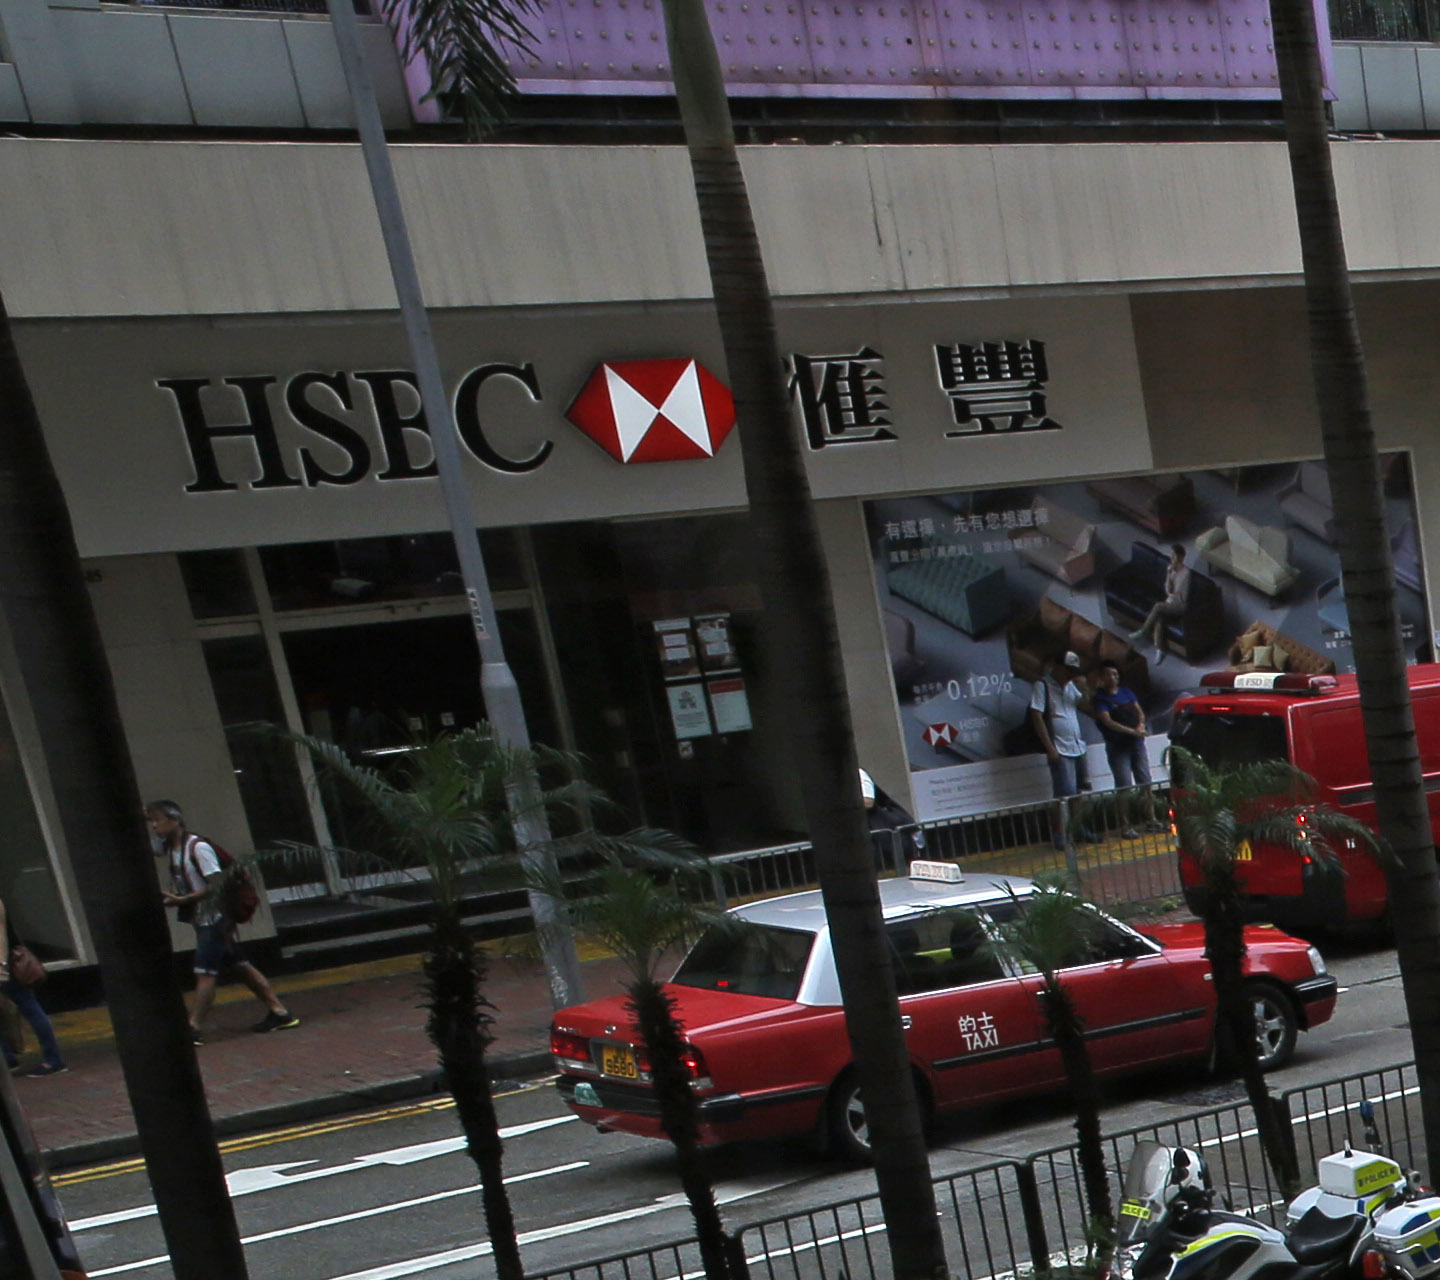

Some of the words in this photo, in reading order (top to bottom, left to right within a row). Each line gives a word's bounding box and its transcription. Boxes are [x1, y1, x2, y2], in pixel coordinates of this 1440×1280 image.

[156, 362, 554, 493] HSBC
[959, 1012, 994, 1032] 的士
[962, 1029, 999, 1050] TAXI
